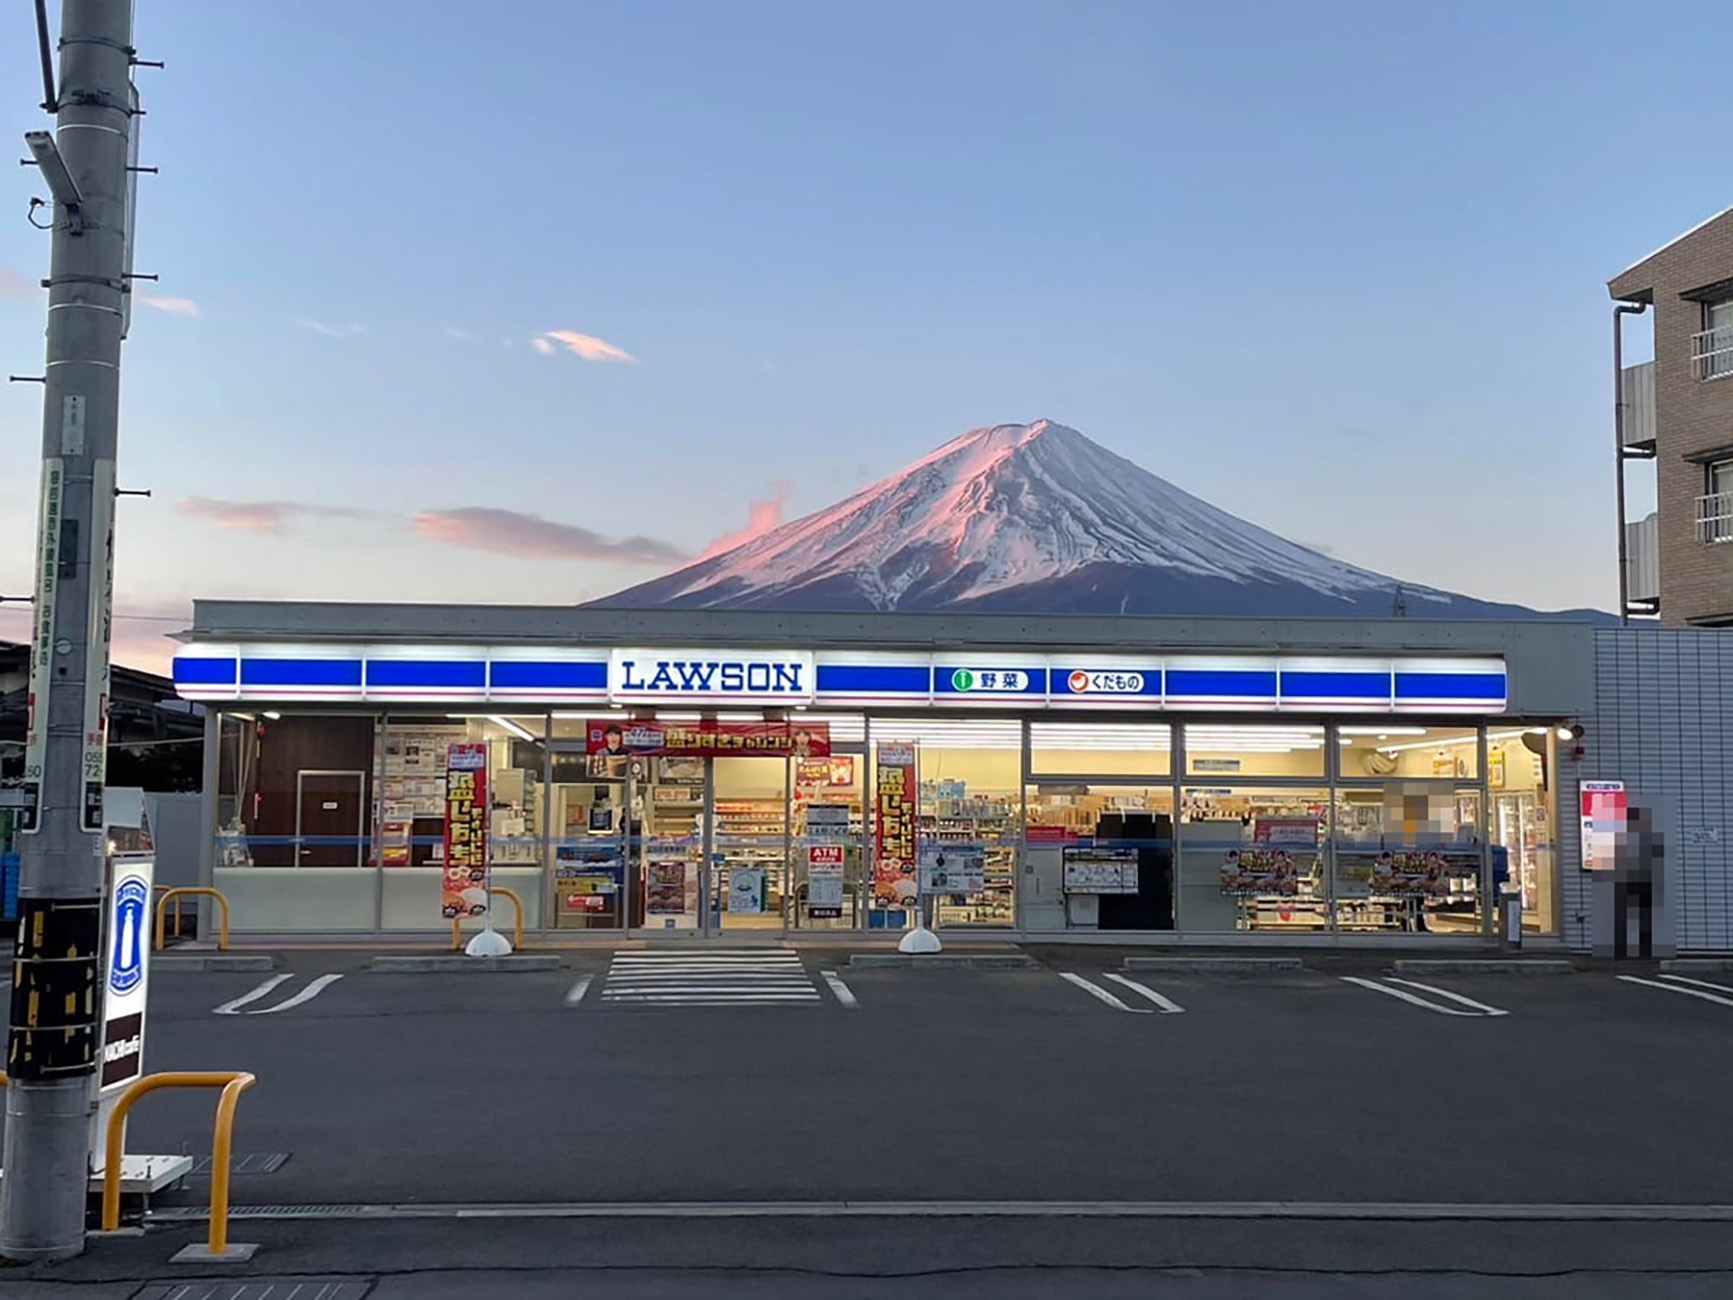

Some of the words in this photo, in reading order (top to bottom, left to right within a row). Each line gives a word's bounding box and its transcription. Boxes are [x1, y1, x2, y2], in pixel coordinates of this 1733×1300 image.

[622, 661, 803, 691] LAWSON
[980, 672, 1018, 688] 野菜
[1092, 674, 1139, 690] くだもの
[813, 848, 839, 857] ATM
